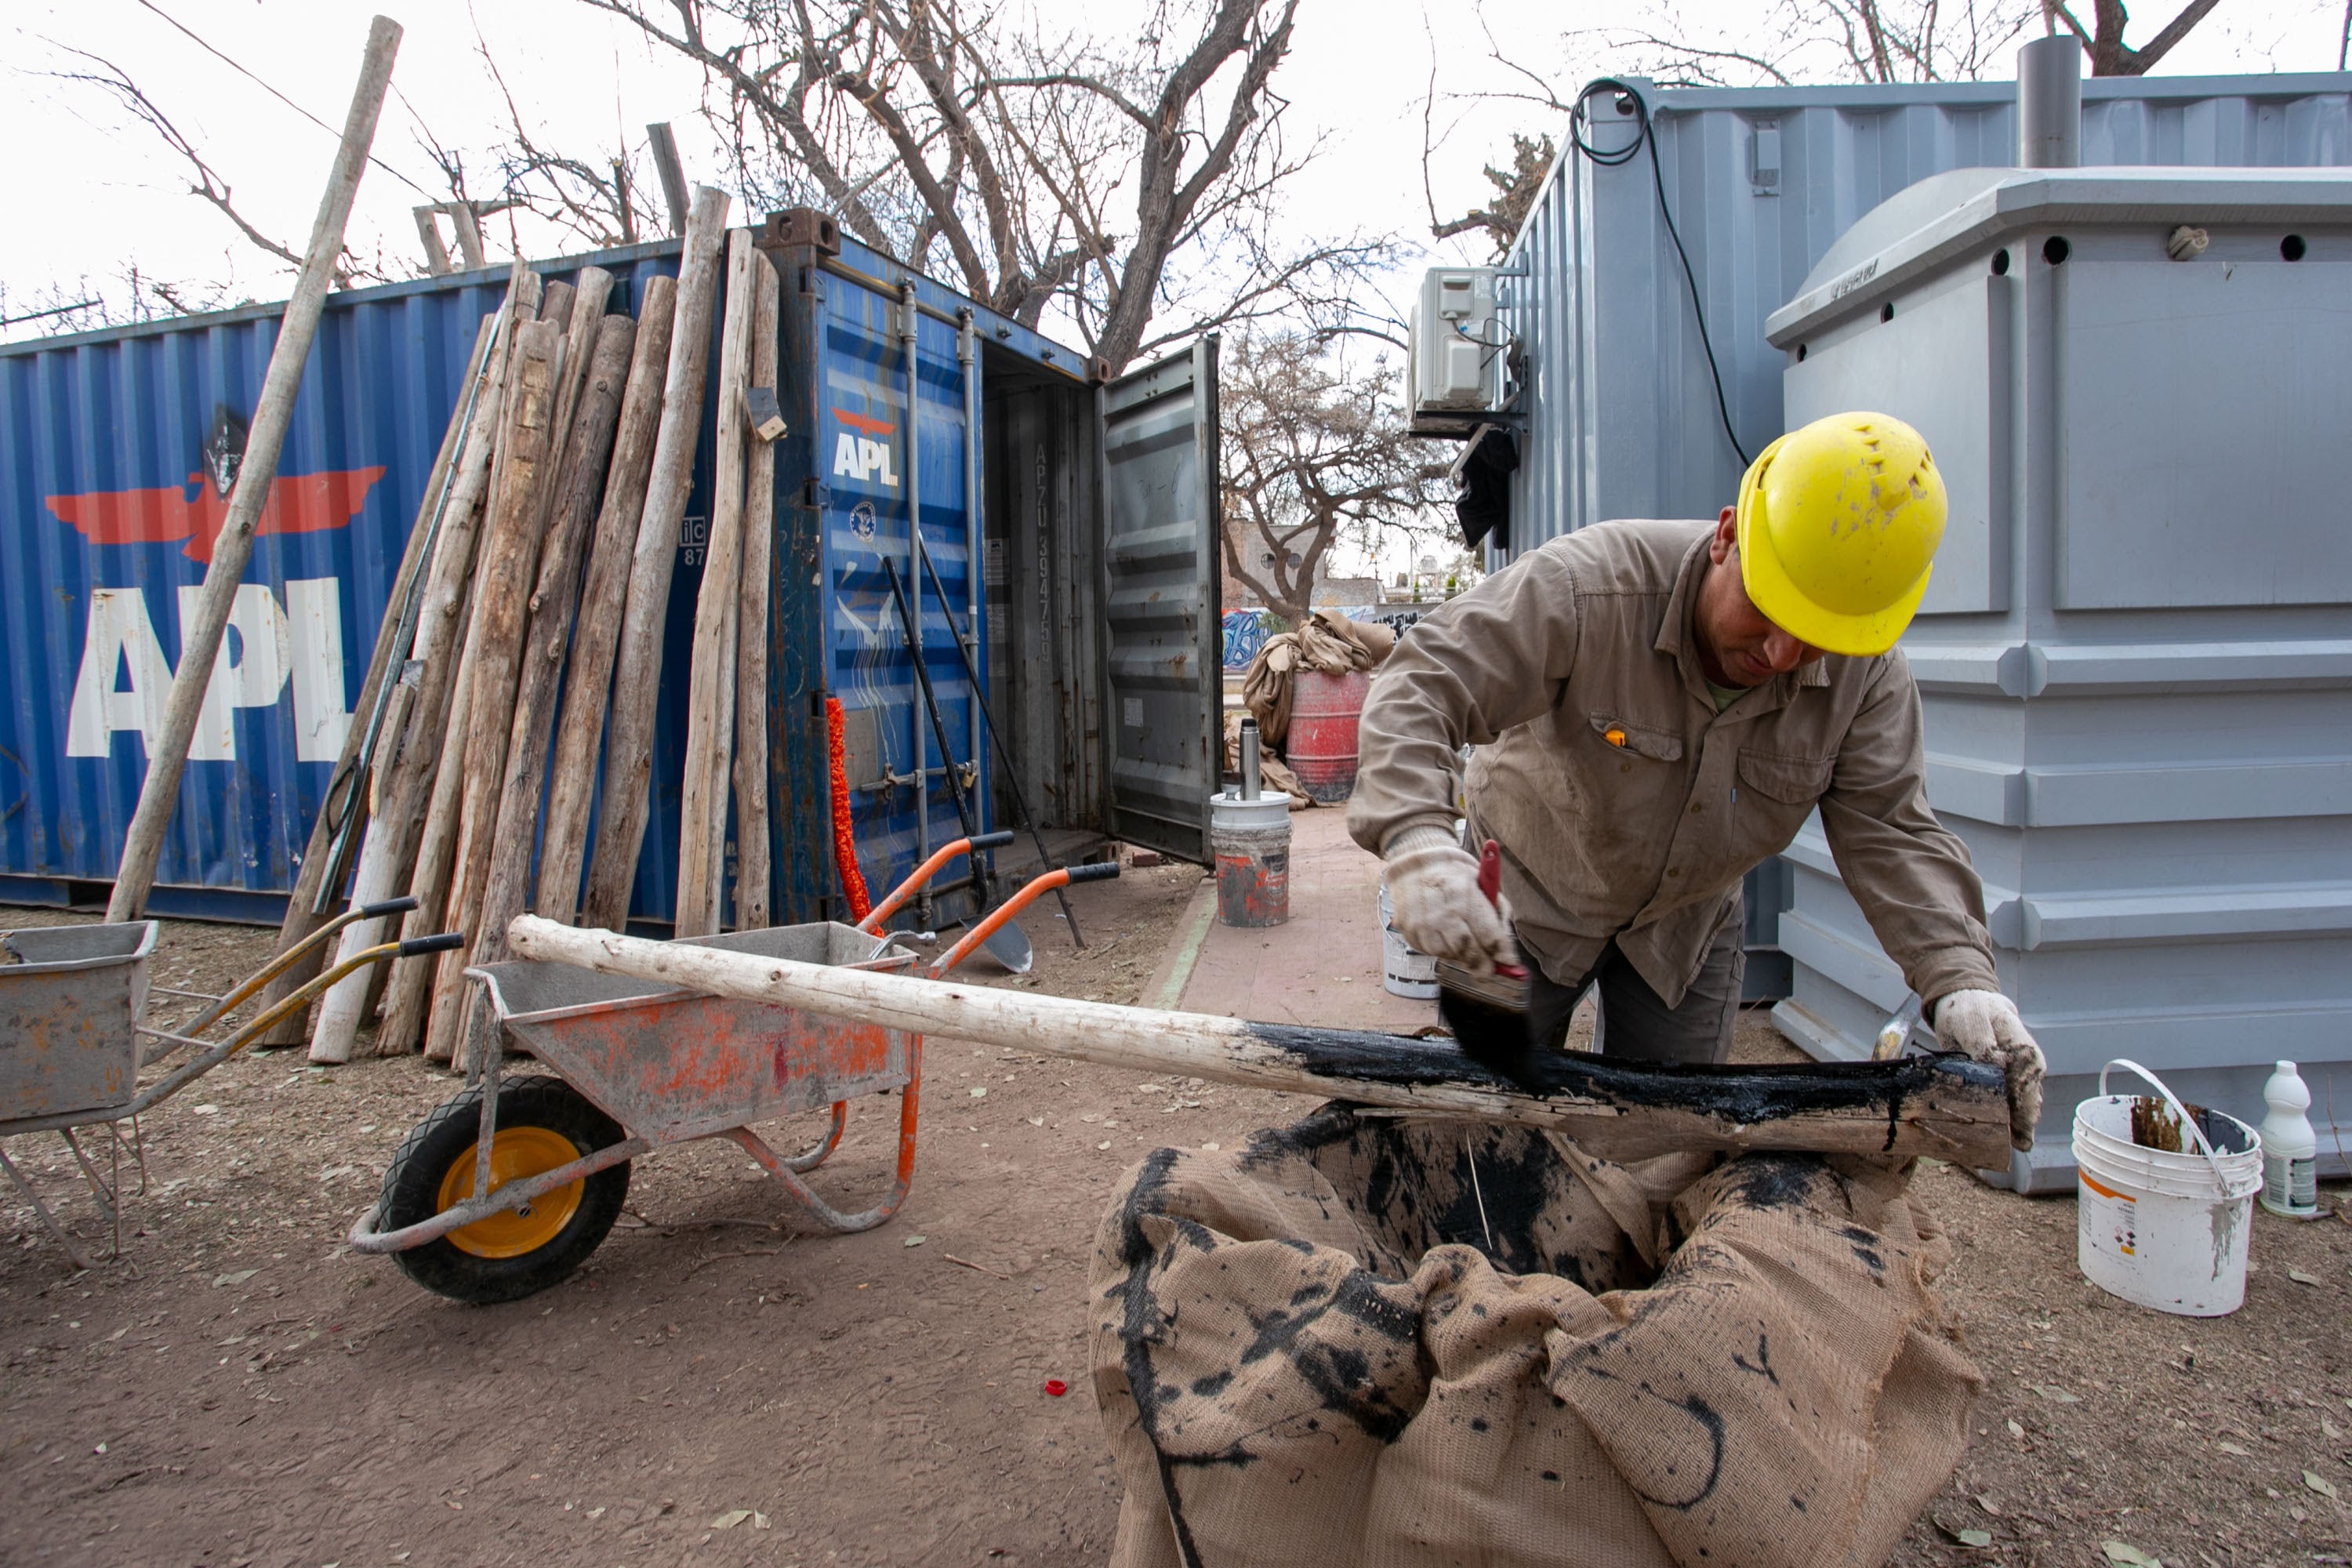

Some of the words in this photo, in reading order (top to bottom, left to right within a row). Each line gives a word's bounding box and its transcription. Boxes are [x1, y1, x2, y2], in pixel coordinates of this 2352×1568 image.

[833, 433, 898, 487] APL
[1035, 443, 1047, 528] APZU
[684, 548, 704, 566] 87
[66, 576, 356, 762] APL
